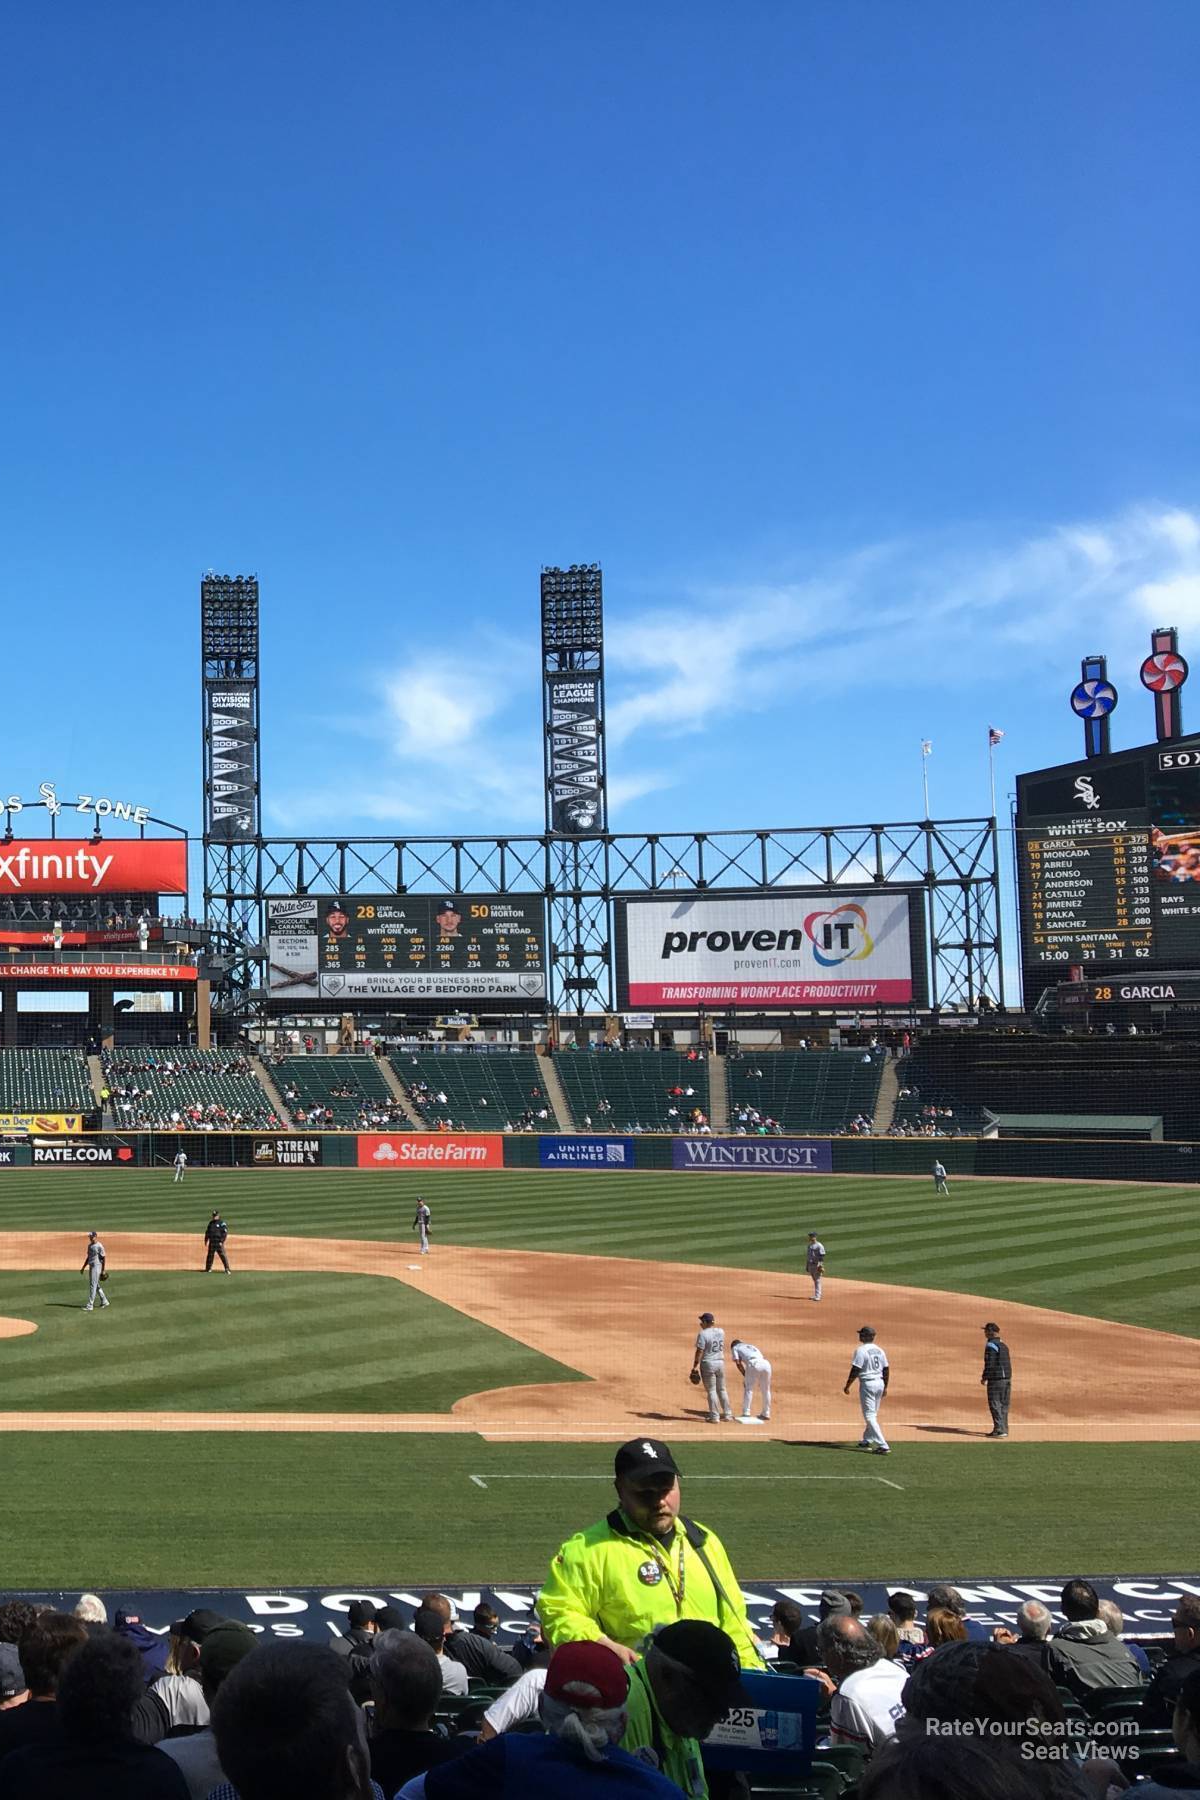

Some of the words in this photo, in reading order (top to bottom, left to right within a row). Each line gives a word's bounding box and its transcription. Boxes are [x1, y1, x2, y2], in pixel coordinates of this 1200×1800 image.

[553, 682, 594, 690] AMERICAN
[554, 690, 594, 698] LEAGUE
[76, 795, 150, 826] ZONE
[1048, 824, 1093, 836] WHITE
[1097, 820, 1128, 832] SOX
[1043, 840, 1076, 848] GARCIA
[1044, 850, 1090, 858] MONCADA
[1044, 860, 1072, 868] ABREU
[1044, 870, 1080, 878] ALONSO
[1045, 880, 1093, 889] ANDERSON
[1045, 890, 1086, 899] CASTILLO
[270, 901, 296, 915] White
[296, 900, 316, 910] Sox
[1046, 900, 1082, 909] JIMENEZ
[357, 906, 374, 918] 28
[470, 905, 488, 918] 50
[1046, 910, 1075, 918] PALKA
[1046, 920, 1087, 929] SANCHEZ
[662, 928, 802, 959] proven
[823, 923, 854, 950] IT
[1048, 935, 1073, 943] ERVIN
[1076, 933, 1118, 942] SANTANA
[1040, 951, 1069, 960] 15.00
[1083, 950, 1096, 959] 31
[1110, 949, 1123, 958] 31
[1136, 948, 1150, 957] 62
[734, 958, 801, 970] provenIT.com
[10, 966, 49, 975] CHANGE
[51, 966, 68, 975] THE
[71, 966, 92, 975] WAY
[95, 966, 113, 975] YOU
[116, 967, 167, 976] EXPERIENCE
[169, 968, 180, 976] TV
[662, 986, 738, 999] TRANSFORMING
[740, 986, 801, 998] WORKPLACE
[803, 984, 876, 998] PRODUCTIVITY
[1095, 988, 1112, 1000] 28
[1120, 986, 1176, 999] GARCIA
[14, 1116, 35, 1125] Beef
[276, 1141, 318, 1151] STREAM
[34, 1148, 112, 1160] RATE.COM
[277, 1152, 304, 1163] YOUR
[684, 1142, 817, 1164] WINTRUST
[640, 1564, 660, 1576] 9.25
